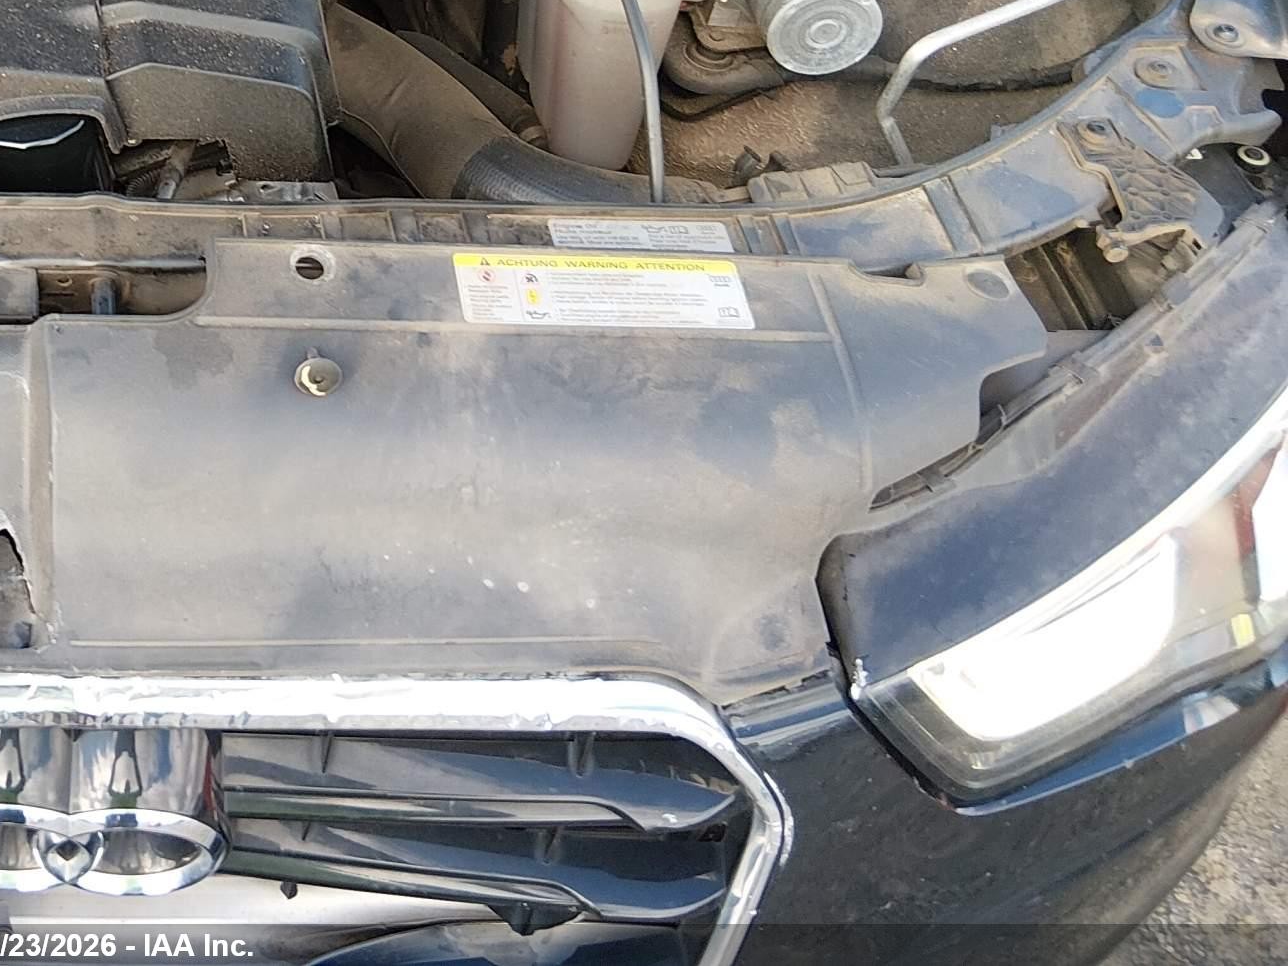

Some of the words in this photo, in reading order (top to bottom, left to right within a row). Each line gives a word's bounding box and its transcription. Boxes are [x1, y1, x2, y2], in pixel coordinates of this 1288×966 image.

[497, 258, 558, 268] ACHTUNG
[564, 260, 628, 270] WARNING
[636, 262, 705, 272] ATTENTION
